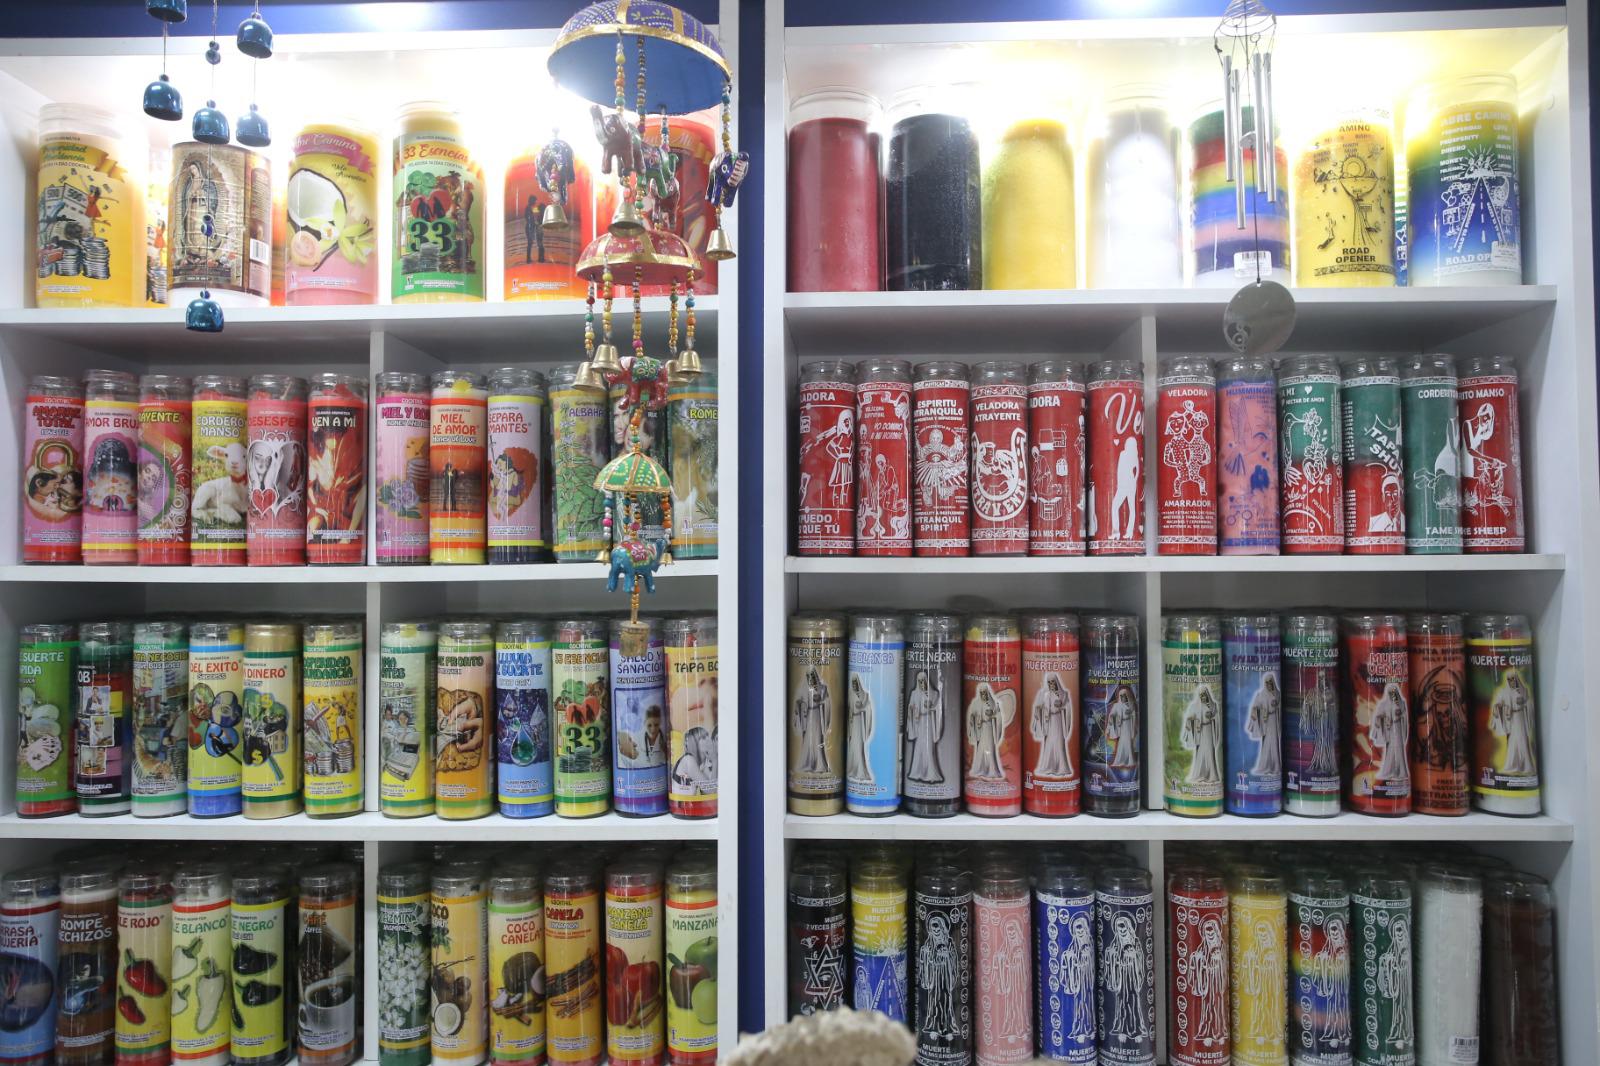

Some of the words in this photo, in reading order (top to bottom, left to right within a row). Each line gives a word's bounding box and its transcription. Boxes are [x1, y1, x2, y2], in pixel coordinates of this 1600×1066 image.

[404, 146, 415, 159] 33
[410, 221, 451, 252] 33
[1343, 247, 1369, 255] ROAD
[1335, 255, 1376, 263] OPENER
[1445, 254, 1475, 265] ROAD
[1476, 388, 1505, 398] MANSO
[918, 400, 956, 408] ESPIRITU
[975, 402, 1019, 411] VELADORA
[405, 407, 414, 418] Y
[690, 408, 718, 419] ROME
[974, 413, 1021, 422] ATRAYENTE
[196, 415, 244, 427] CORDERO
[312, 416, 330, 428] VEN
[333, 417, 341, 426] A
[440, 414, 465, 424] MIEL
[200, 427, 240, 437] MANSO
[433, 425, 443, 434] DE
[446, 424, 475, 435] AMOR
[803, 525, 820, 534] QUE
[825, 523, 840, 534] TÚ
[1425, 527, 1452, 535] TAME
[1474, 527, 1507, 535] SHEEP
[24, 652, 64, 662] SUERTE
[857, 653, 894, 664] BLANCA
[928, 651, 956, 662] NEGRA
[206, 661, 239, 672] EXITO
[674, 662, 704, 673] TAPA
[1108, 660, 1136, 669] MUERTE
[248, 668, 285, 679] DINERO
[566, 727, 600, 755] 33
[546, 908, 584, 921] CANELA
[61, 918, 104, 930] ROMPE
[130, 916, 160, 928] ROJO
[182, 918, 227, 933] BLANCO
[239, 921, 273, 931] NEGRO
[507, 921, 535, 933] COCO
[501, 932, 540, 944] CANELA
[923, 1044, 950, 1053] MUERTE
[1110, 1047, 1140, 1055] MUERTE
